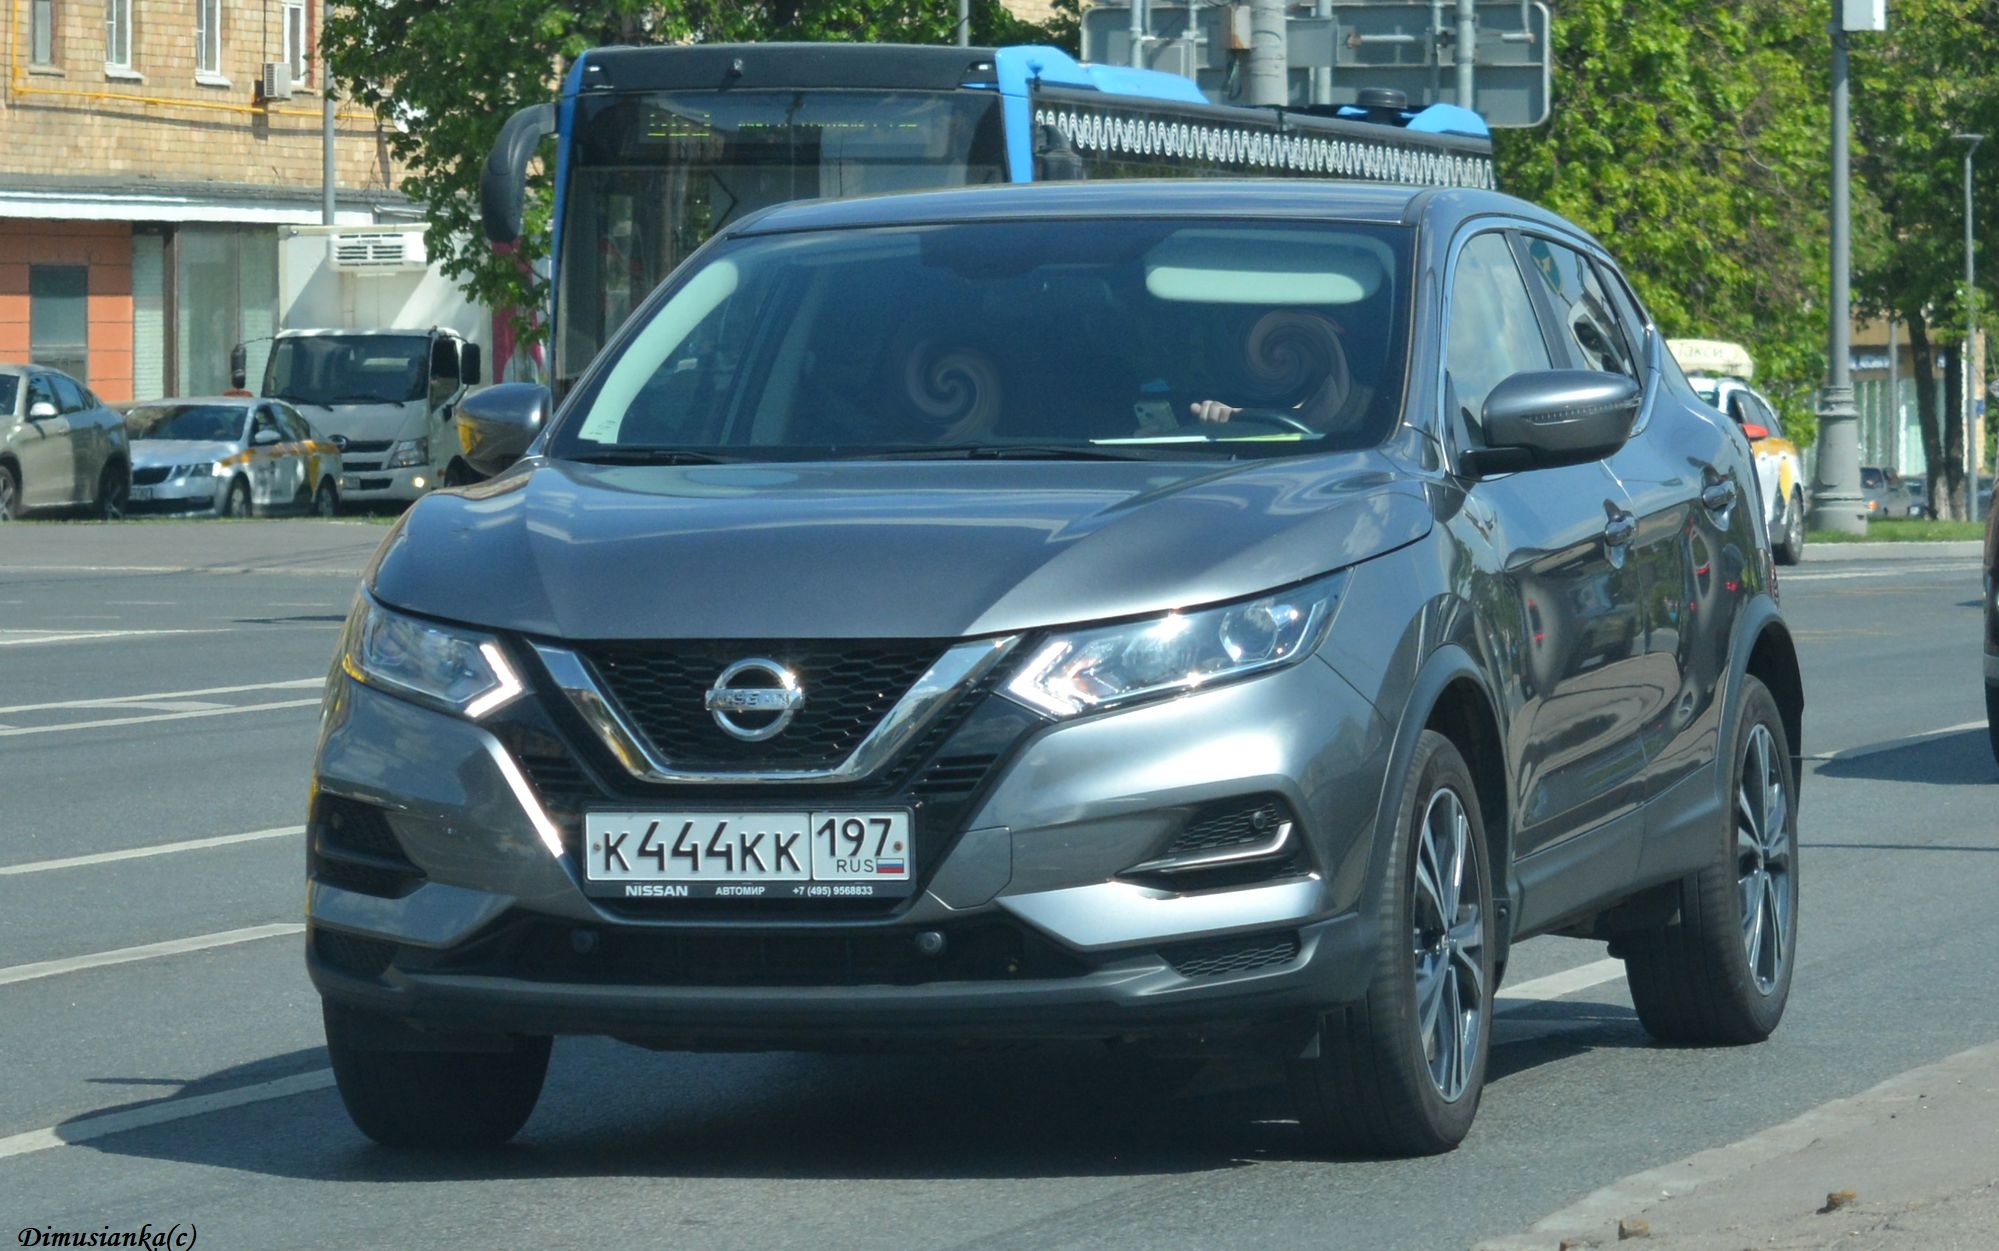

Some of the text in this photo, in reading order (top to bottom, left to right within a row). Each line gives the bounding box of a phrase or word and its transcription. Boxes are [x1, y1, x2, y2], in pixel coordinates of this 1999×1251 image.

[816, 817, 893, 857] 197
[836, 858, 875, 873] RUS
[625, 885, 688, 897] NISSAN
[715, 886, 766, 896] АВТОМИР
[792, 886, 805, 896] +7
[807, 885, 832, 898] (495)
